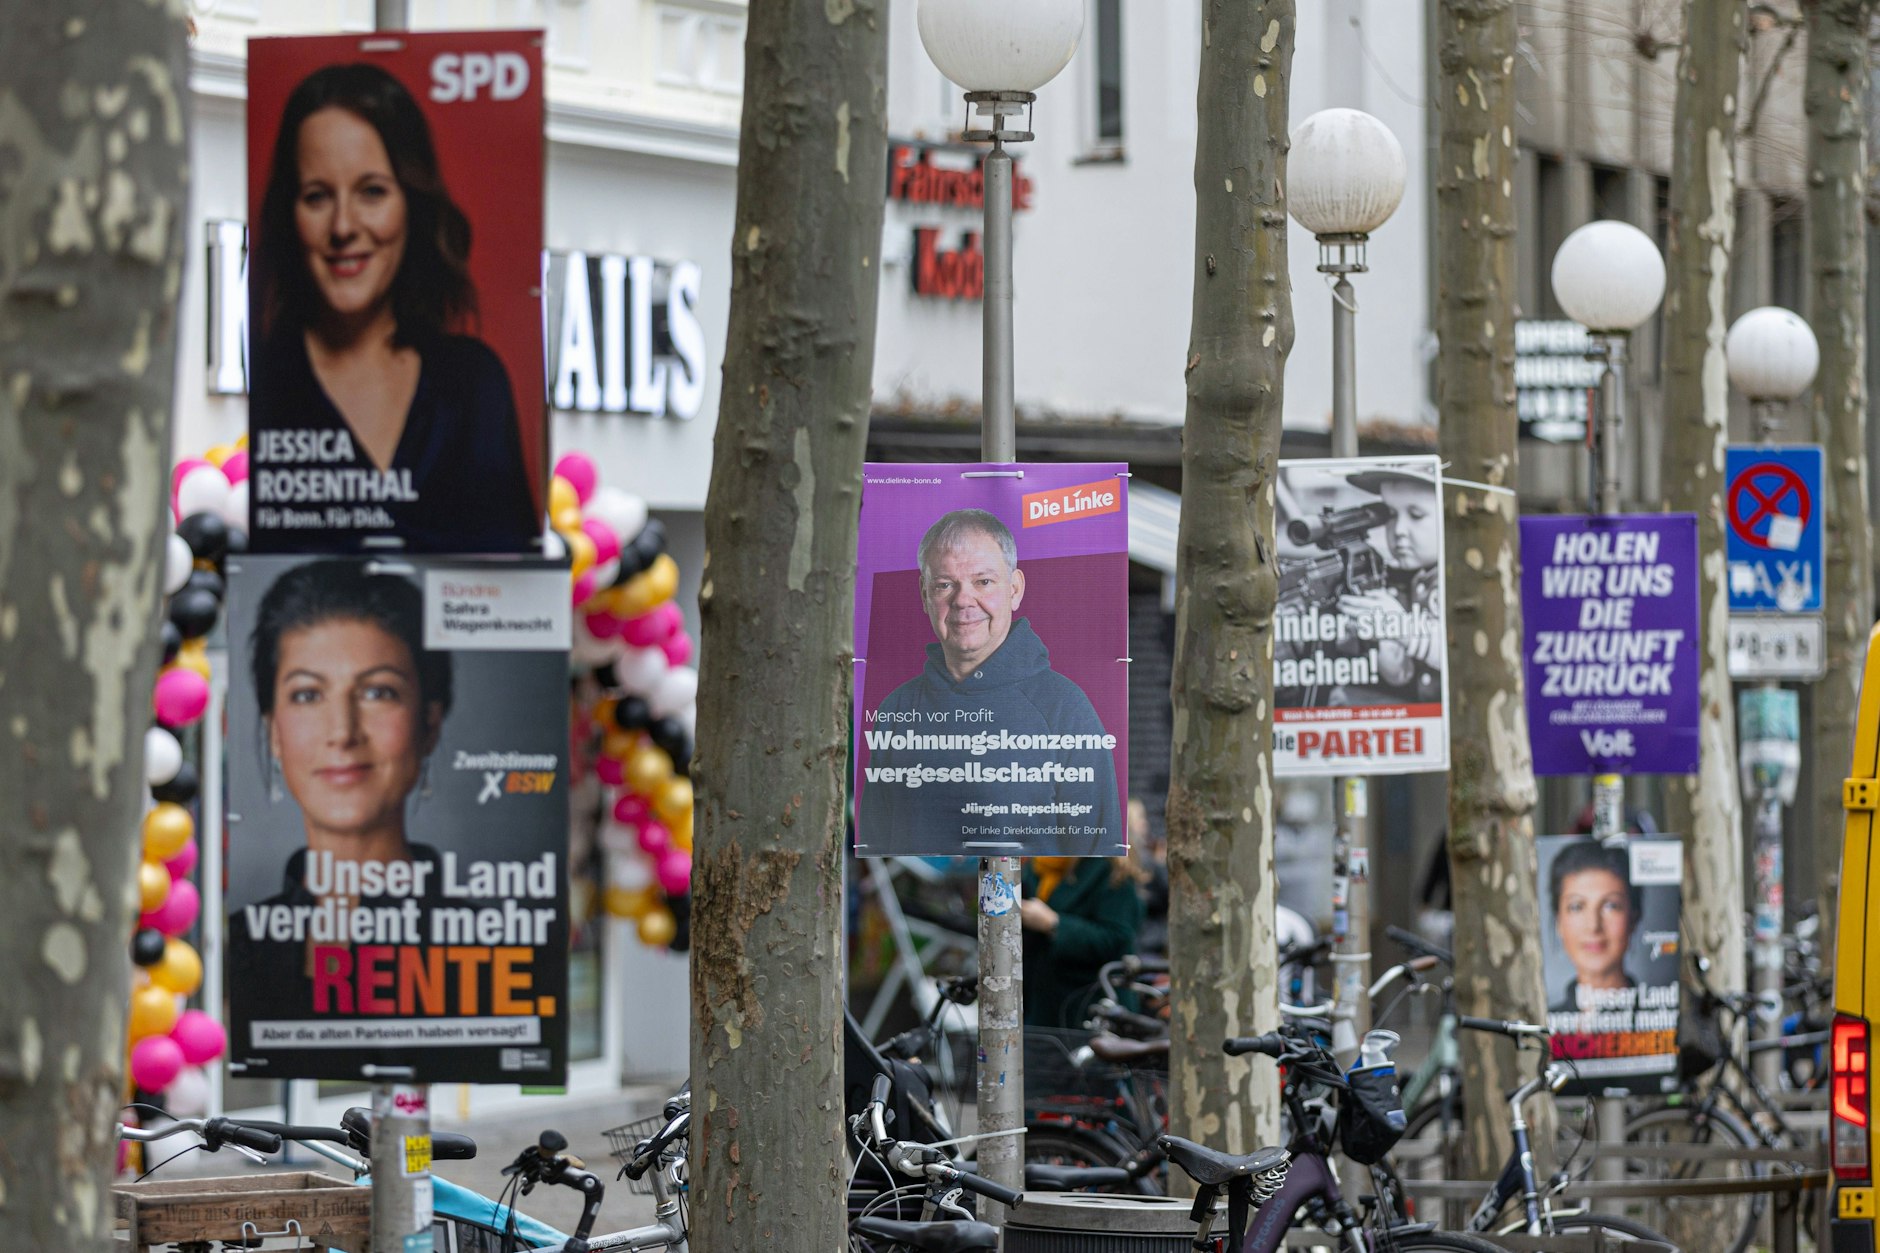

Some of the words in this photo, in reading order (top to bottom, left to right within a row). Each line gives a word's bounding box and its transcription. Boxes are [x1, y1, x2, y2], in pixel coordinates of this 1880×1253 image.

[429, 52, 530, 103] SPD
[256, 428, 355, 462] JESSICA
[256, 468, 419, 502] ROSENTHAL
[867, 477, 942, 485] www.dielinke-bonn.de
[1029, 499, 1060, 520] Die
[1063, 490, 1114, 513] Linke
[1552, 531, 1660, 565] HOLEN
[1541, 566, 1603, 598] WIR
[1605, 564, 1675, 597] UNS
[443, 602, 490, 614] Sahra
[1274, 605, 1350, 641] inder
[1357, 602, 1428, 640] stark
[1579, 598, 1635, 630] DIE
[443, 618, 553, 633] Wagenknecht
[1532, 630, 1684, 665] ZUKUNFT
[1540, 660, 1675, 697] ZURÜCK
[865, 709, 922, 723] Mensch
[927, 712, 950, 723] vor
[955, 709, 994, 723] Profit
[864, 729, 1117, 755] Wohnungskonzerne
[1297, 727, 1424, 758] PARTEI
[452, 750, 558, 771] Zweitstimme
[864, 762, 1095, 788] vergesellschaften
[505, 771, 557, 794] BSW
[961, 803, 1008, 817] Jürgen
[1011, 803, 1093, 817] Repschläger
[962, 826, 977, 835] Der
[980, 826, 1001, 835] linke
[1003, 825, 1066, 835] Direktkandidat
[1068, 825, 1081, 835] für
[1084, 826, 1107, 835] Bonn
[305, 851, 432, 898] Unser
[443, 852, 556, 898] Land
[245, 898, 420, 942] verdient
[431, 901, 556, 944] mehr
[314, 946, 556, 1017] RENTE.
[1638, 980, 1679, 1010] Land
[262, 1028, 292, 1041] Aber
[296, 1028, 314, 1040] die
[319, 1027, 351, 1040] alten
[355, 1025, 413, 1040] Parteien
[418, 1023, 464, 1039] haben
[468, 1023, 528, 1039] versagt!
